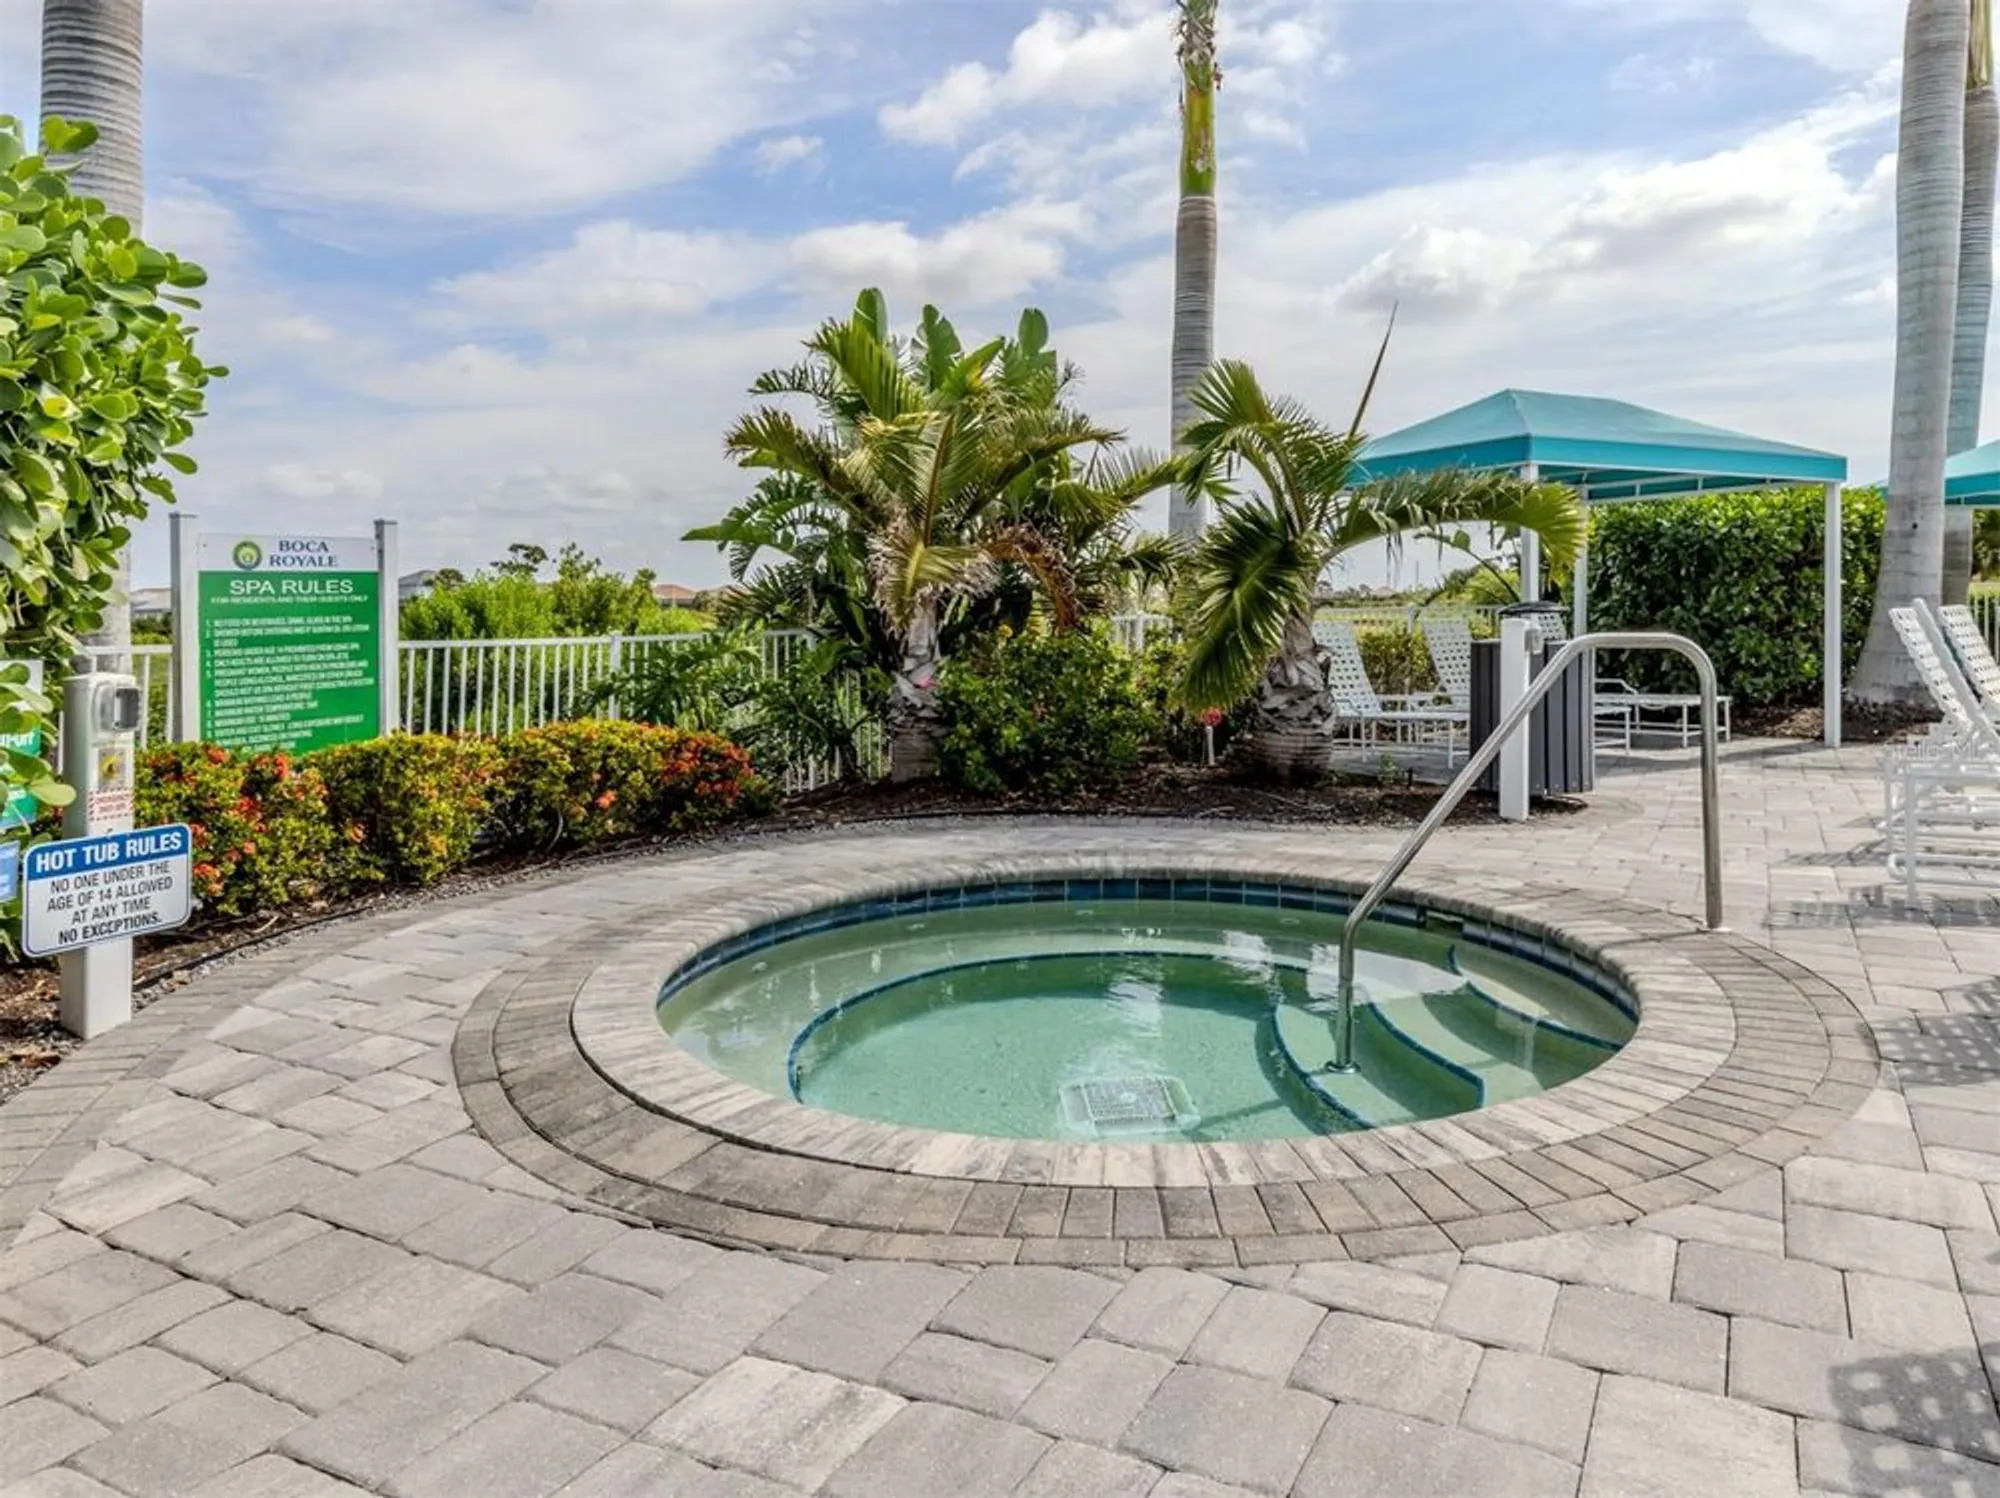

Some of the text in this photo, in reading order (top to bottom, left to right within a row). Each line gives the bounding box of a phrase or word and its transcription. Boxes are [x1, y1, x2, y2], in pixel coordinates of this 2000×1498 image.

[269, 555, 338, 567] ROYALE
[279, 540, 329, 552] BOCA
[229, 579, 354, 595] SPA RULES
[36, 848, 77, 873] HOT
[82, 842, 120, 865] TUB
[125, 832, 181, 859] RULES
[50, 860, 171, 894] NO ONE UNDER THE
[46, 876, 173, 912] AGE OF 14 ALLOWED
[71, 896, 151, 925] AT ANY TIME
[58, 911, 162, 945] NO EXCEPTIONS.
